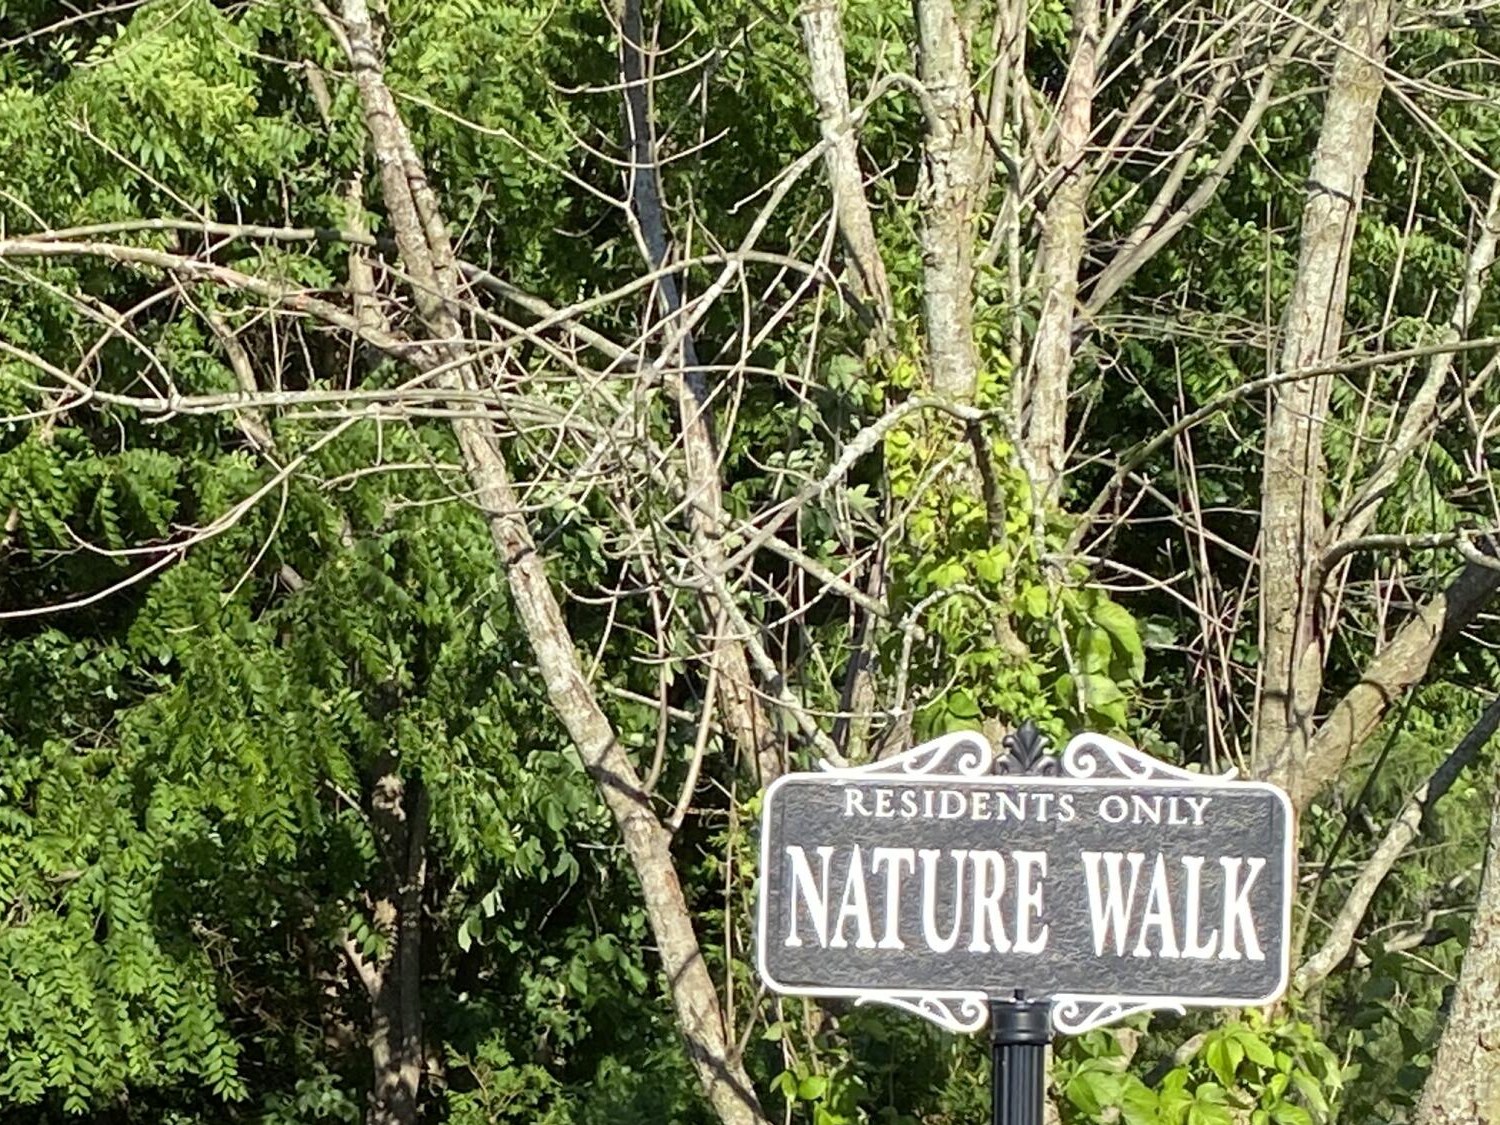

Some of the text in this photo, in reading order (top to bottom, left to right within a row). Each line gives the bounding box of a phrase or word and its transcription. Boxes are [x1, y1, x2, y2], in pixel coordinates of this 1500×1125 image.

[844, 787, 1213, 826] RESIDENTS ONLY
[784, 843, 1267, 961] NATURE WALK
